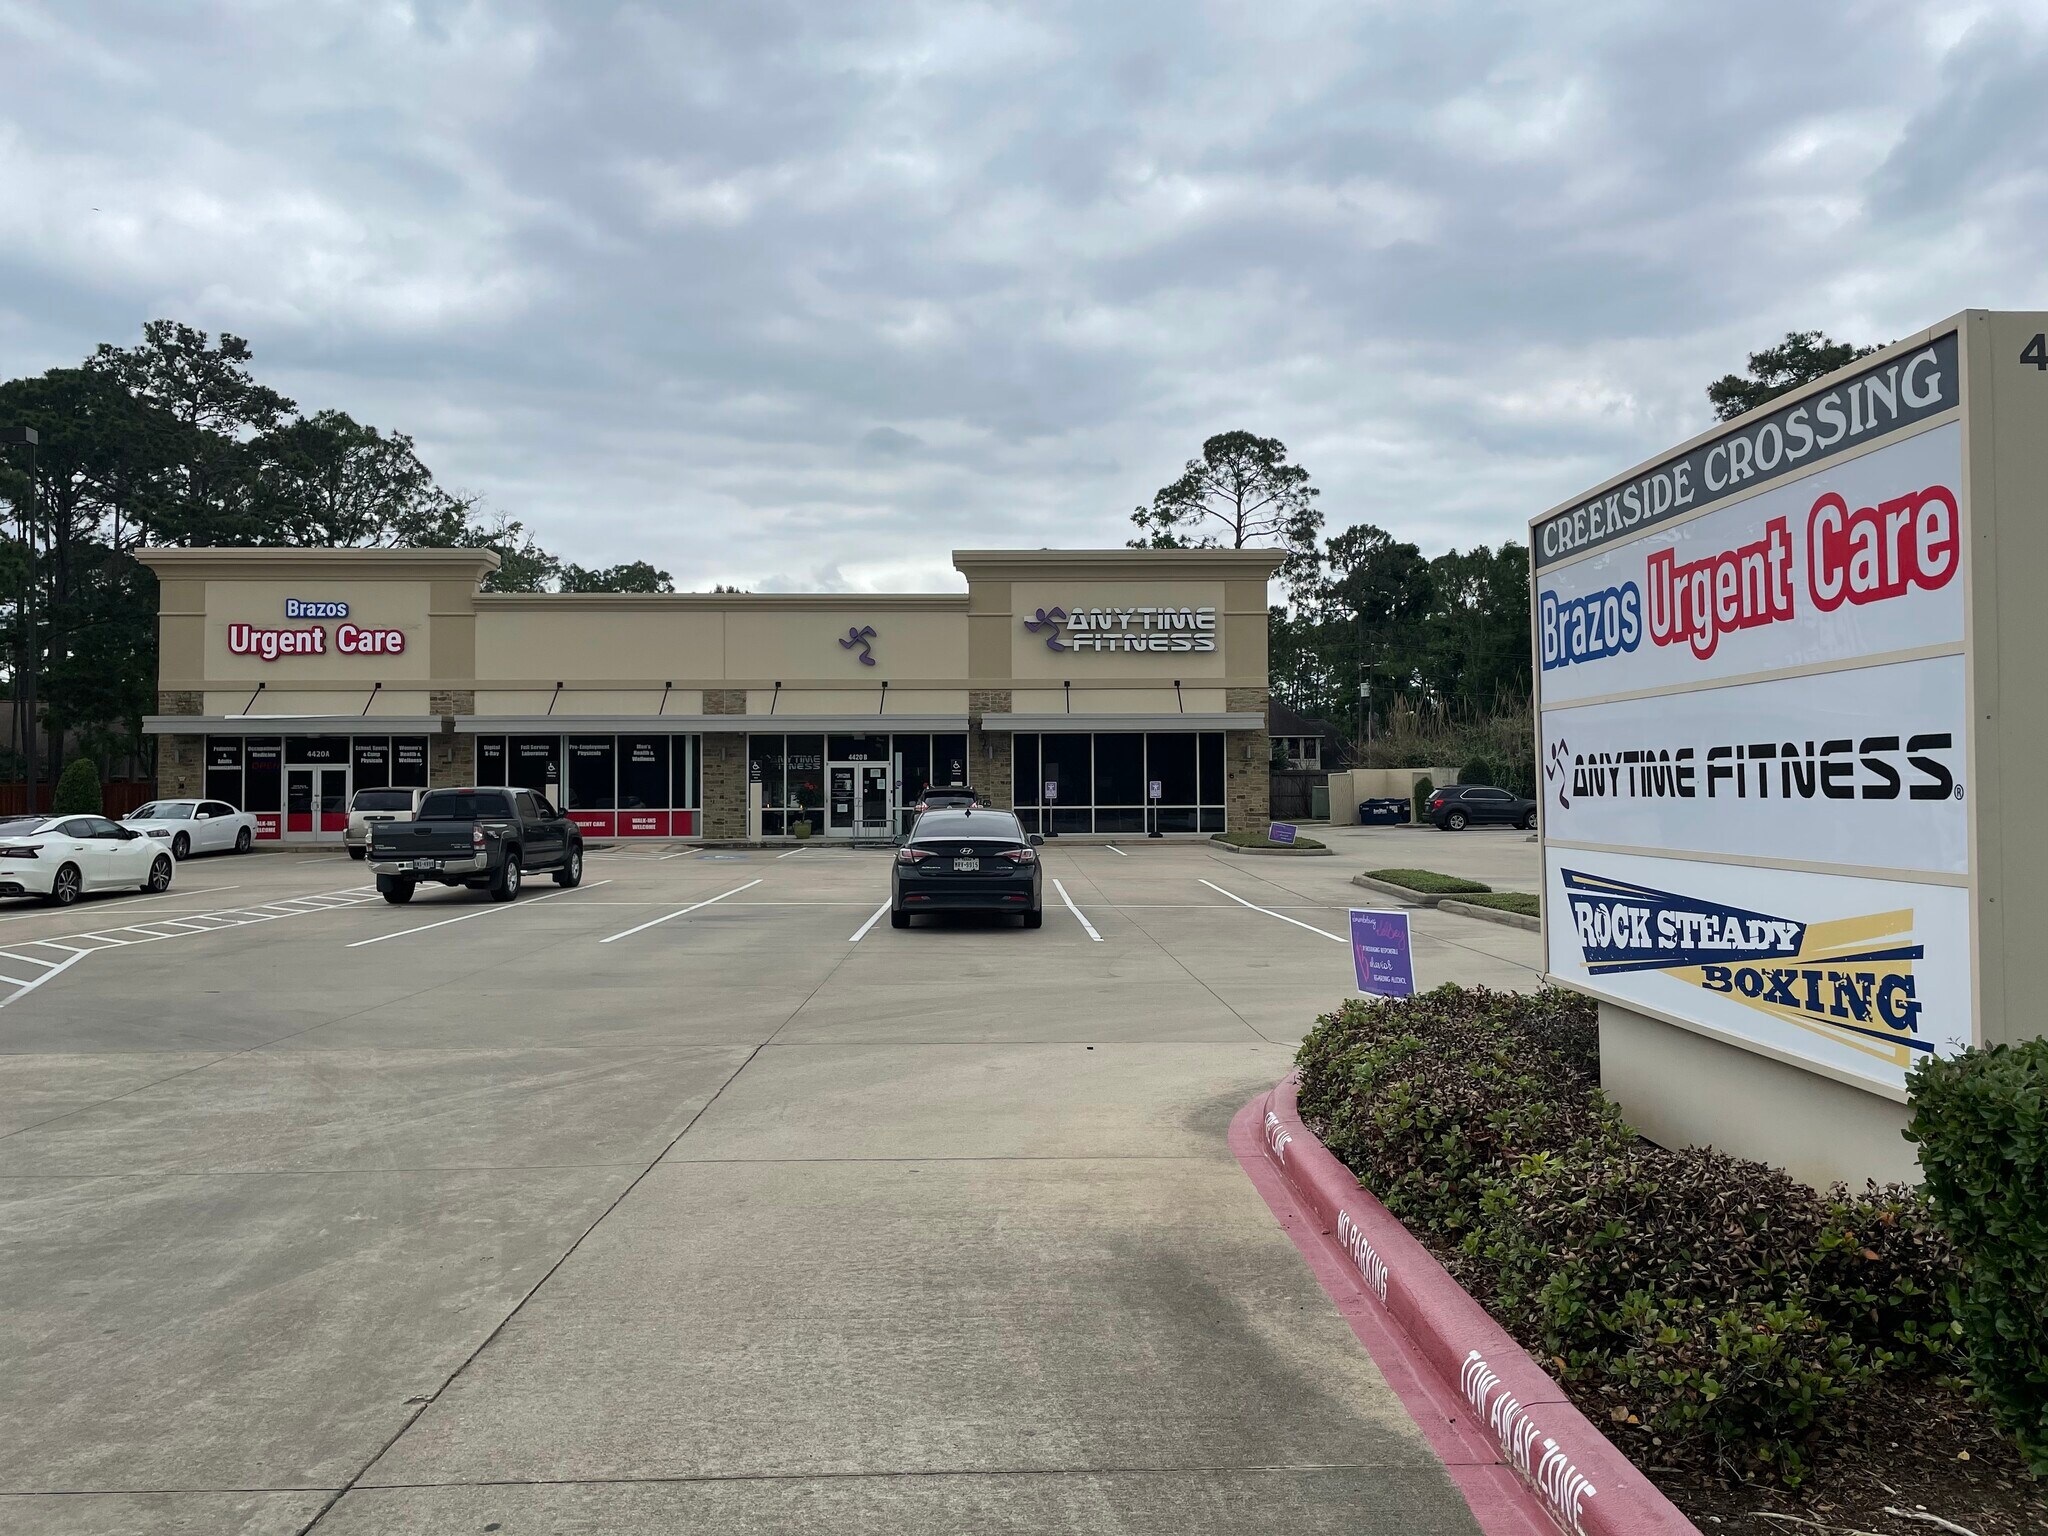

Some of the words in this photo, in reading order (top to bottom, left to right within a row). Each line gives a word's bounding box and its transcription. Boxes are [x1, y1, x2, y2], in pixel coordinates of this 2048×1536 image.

[1543, 460, 1695, 558] CREEKSIDE
[1704, 348, 1943, 491] CROSSING
[1541, 582, 1640, 670] Brazos
[1648, 516, 1795, 659] Urgent
[1808, 485, 1959, 612] Care
[286, 599, 348, 618] Brazos
[1066, 607, 1216, 630] ANYTIME
[229, 624, 325, 661] Urgent
[337, 624, 404, 655] Care
[1073, 633, 1216, 651] FITNESS
[1572, 747, 1696, 799] ANYTIME
[1575, 902, 1652, 950] ROCK
[1656, 909, 1800, 952] STEADY
[1701, 966, 1923, 1034] BOXING
[1338, 1209, 1350, 1248] NO
[1350, 1223, 1388, 1303] PARKING
[1461, 1350, 1500, 1420] TOW
[1491, 1391, 1541, 1474] AWAY
[1538, 1438, 1597, 1530] ZONE
